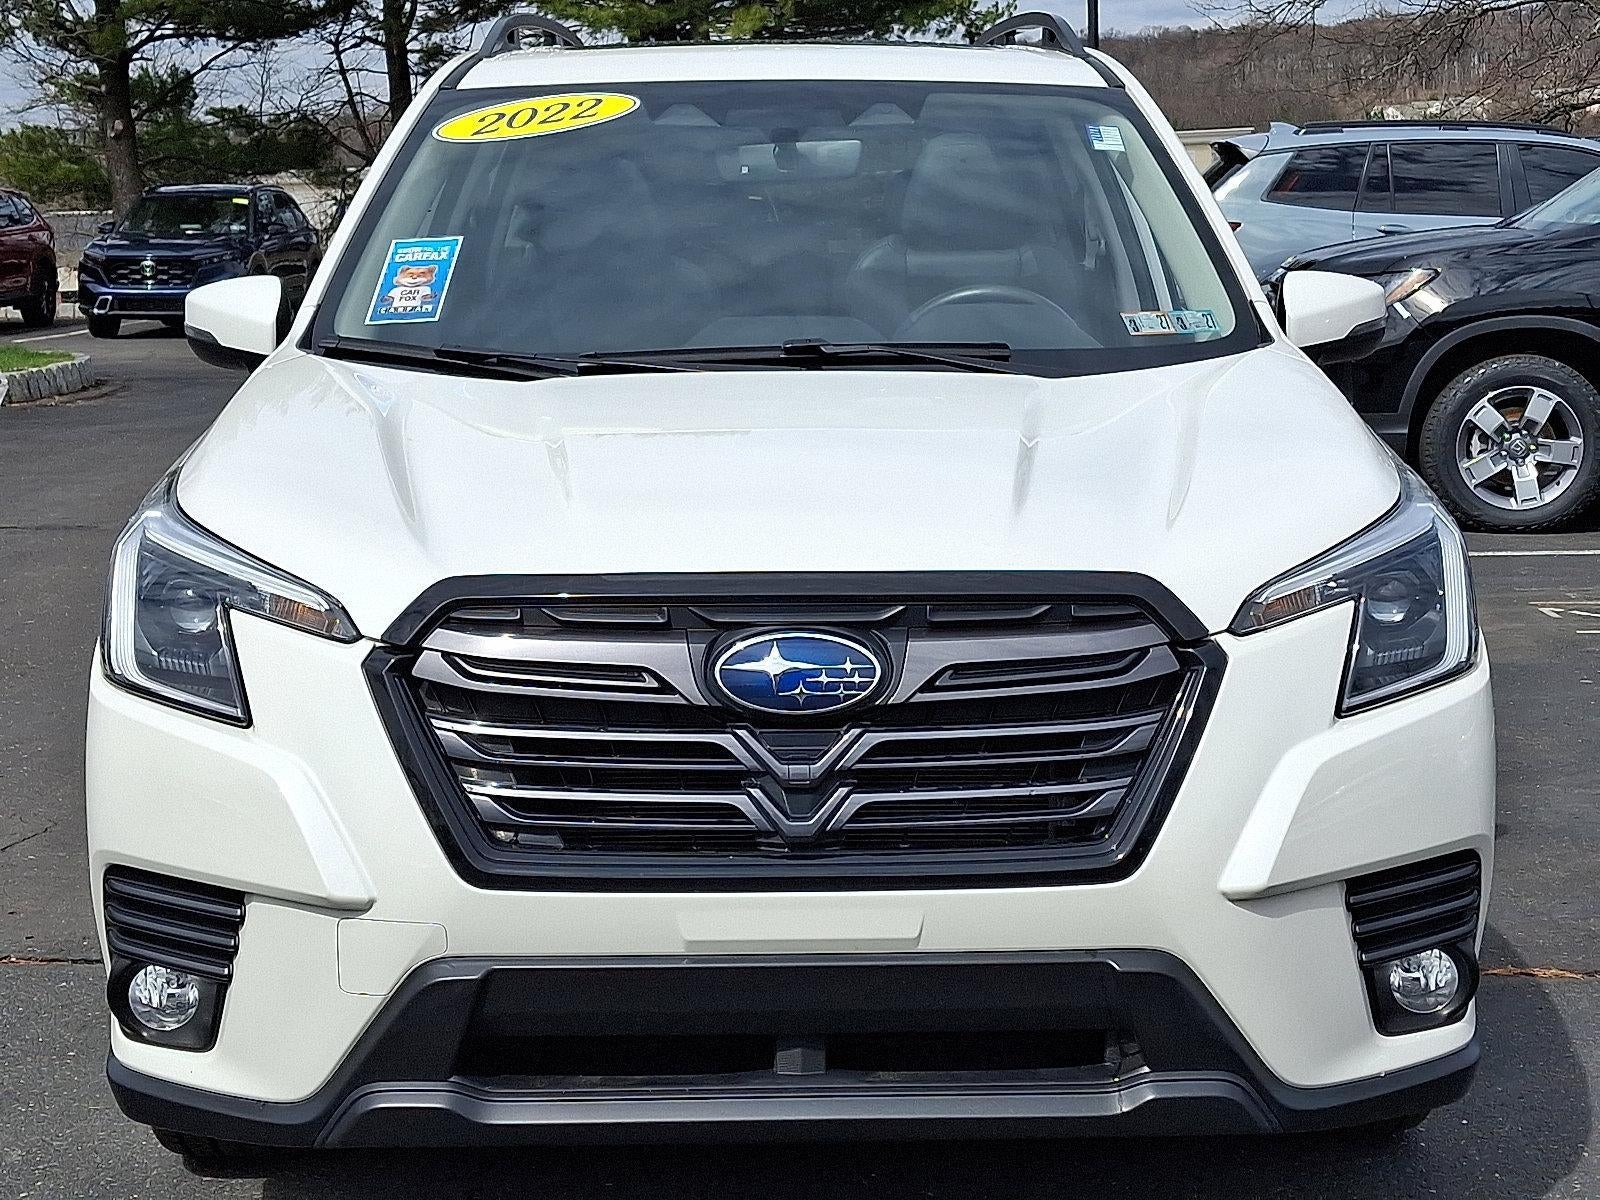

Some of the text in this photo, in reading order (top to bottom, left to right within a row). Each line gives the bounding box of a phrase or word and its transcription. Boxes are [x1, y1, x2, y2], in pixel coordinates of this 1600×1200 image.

[470, 97, 603, 137] 2022
[395, 251, 448, 262] CARFAX
[1156, 315, 1170, 330] 27
[1202, 313, 1217, 329] 27
